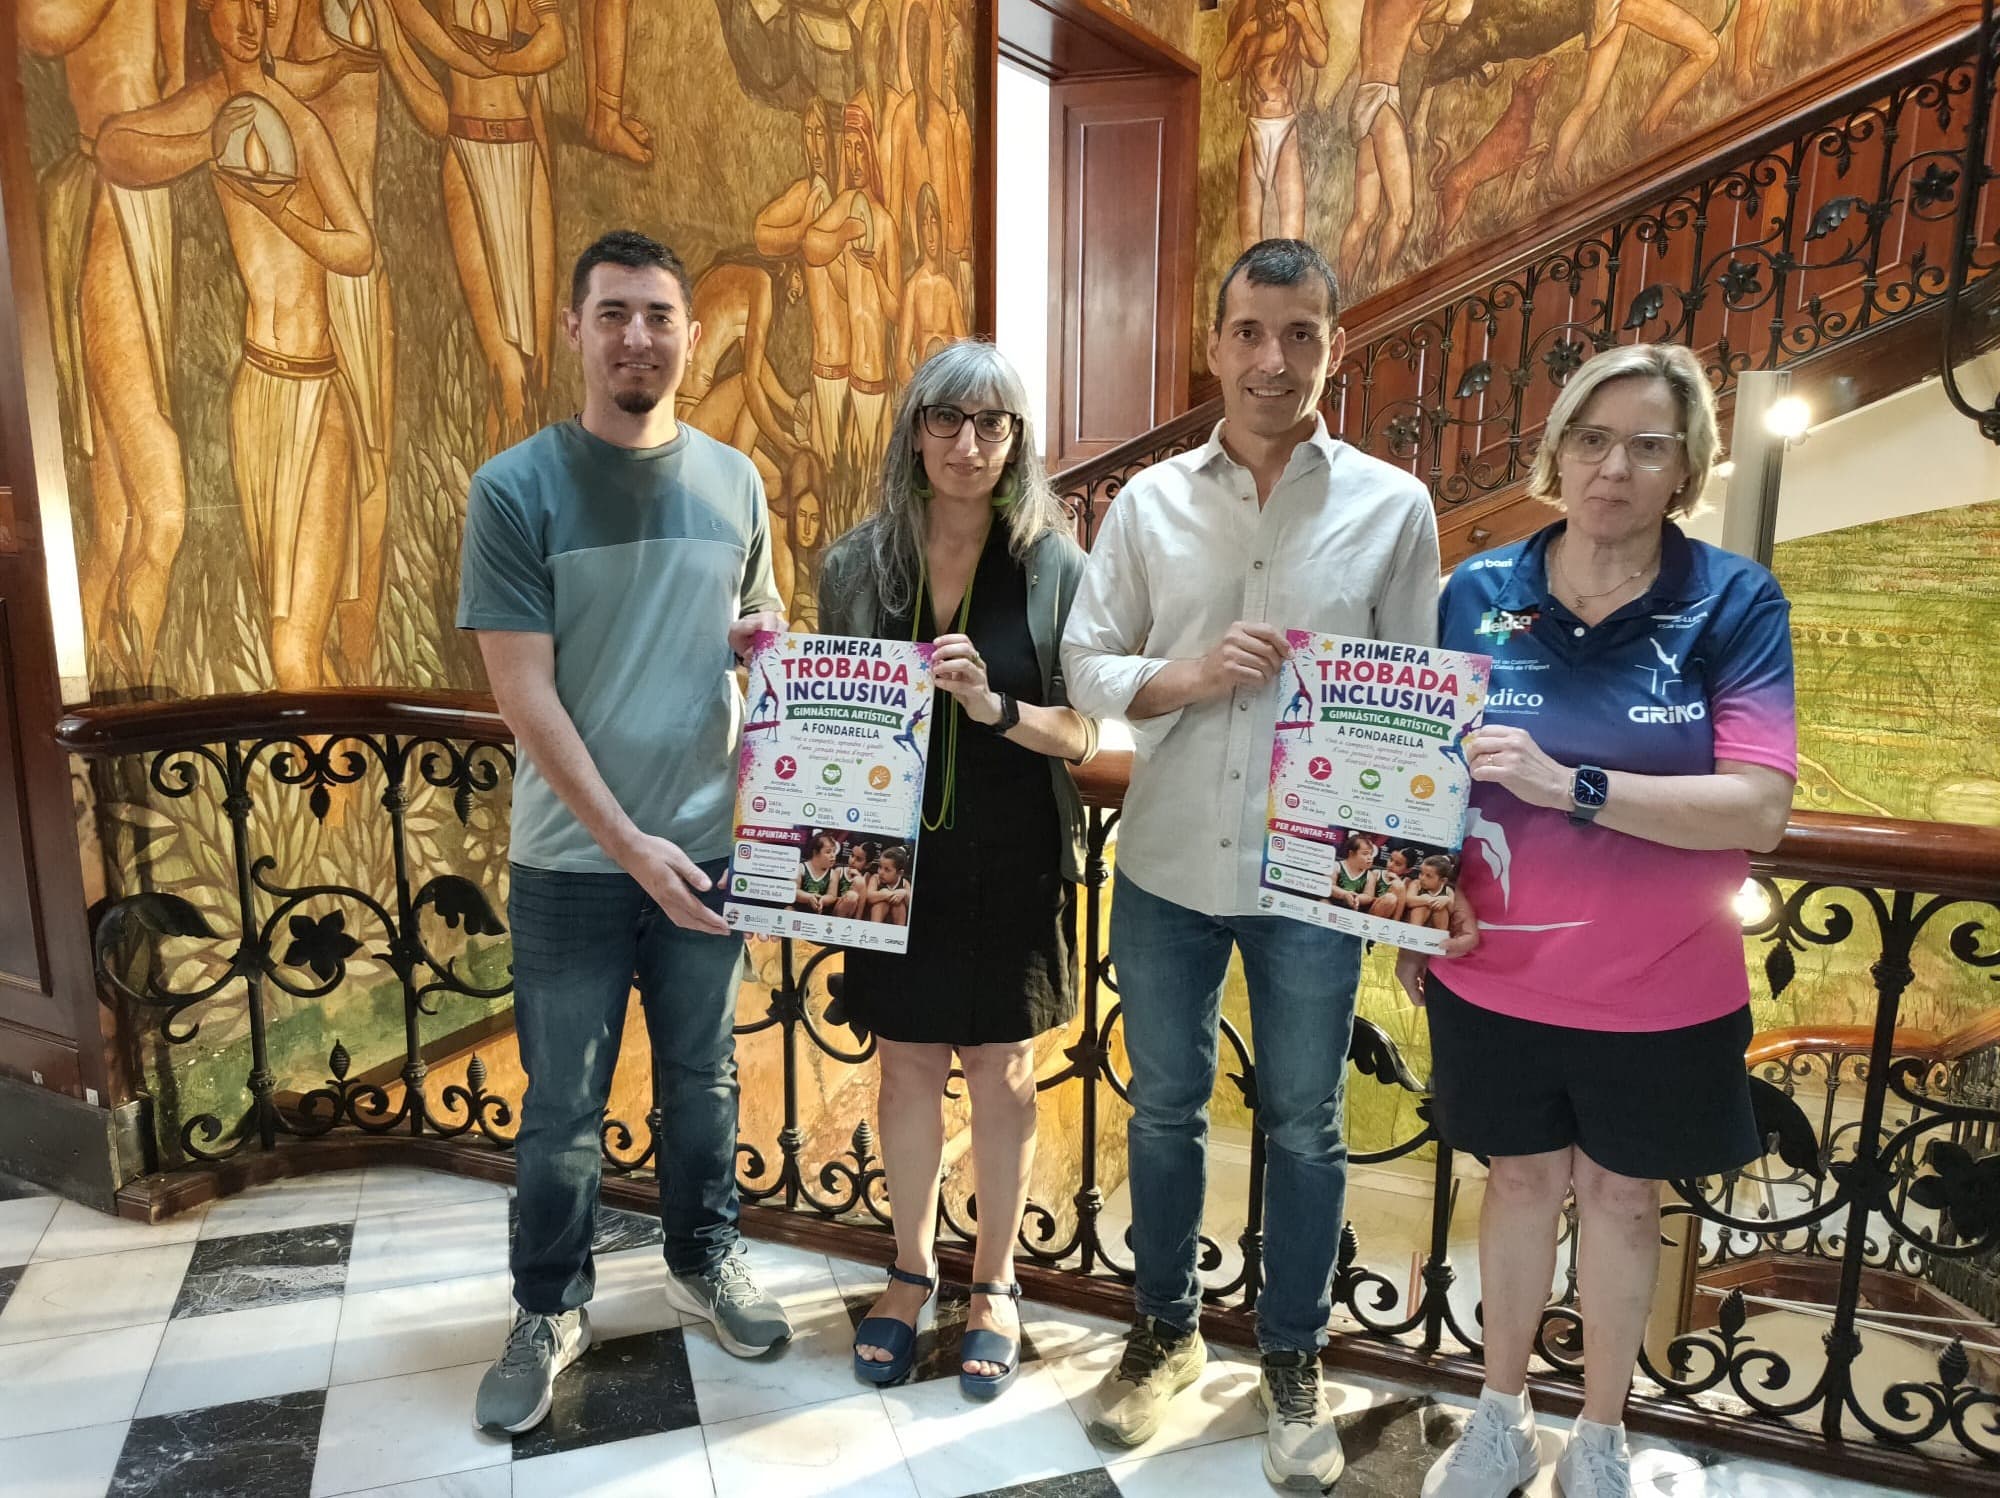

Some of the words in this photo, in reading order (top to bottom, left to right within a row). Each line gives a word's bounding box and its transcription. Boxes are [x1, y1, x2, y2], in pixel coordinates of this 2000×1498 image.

[804, 639, 882, 659] PRIMERA
[1341, 643, 1430, 666] PRIMERA
[781, 657, 909, 686] TROBADA
[1316, 660, 1458, 697] TROBADA
[786, 680, 907, 709] INCLUSIVA
[1321, 684, 1456, 720] INCLUSIVA
[802, 722, 809, 733] A
[812, 723, 880, 739] FONDARELLA
[1329, 710, 1391, 724] GIMNÀSTICA
[1392, 718, 1443, 735] ARTÍSTICA
[1337, 726, 1345, 736] A
[1349, 727, 1424, 748] FONDARELLA
